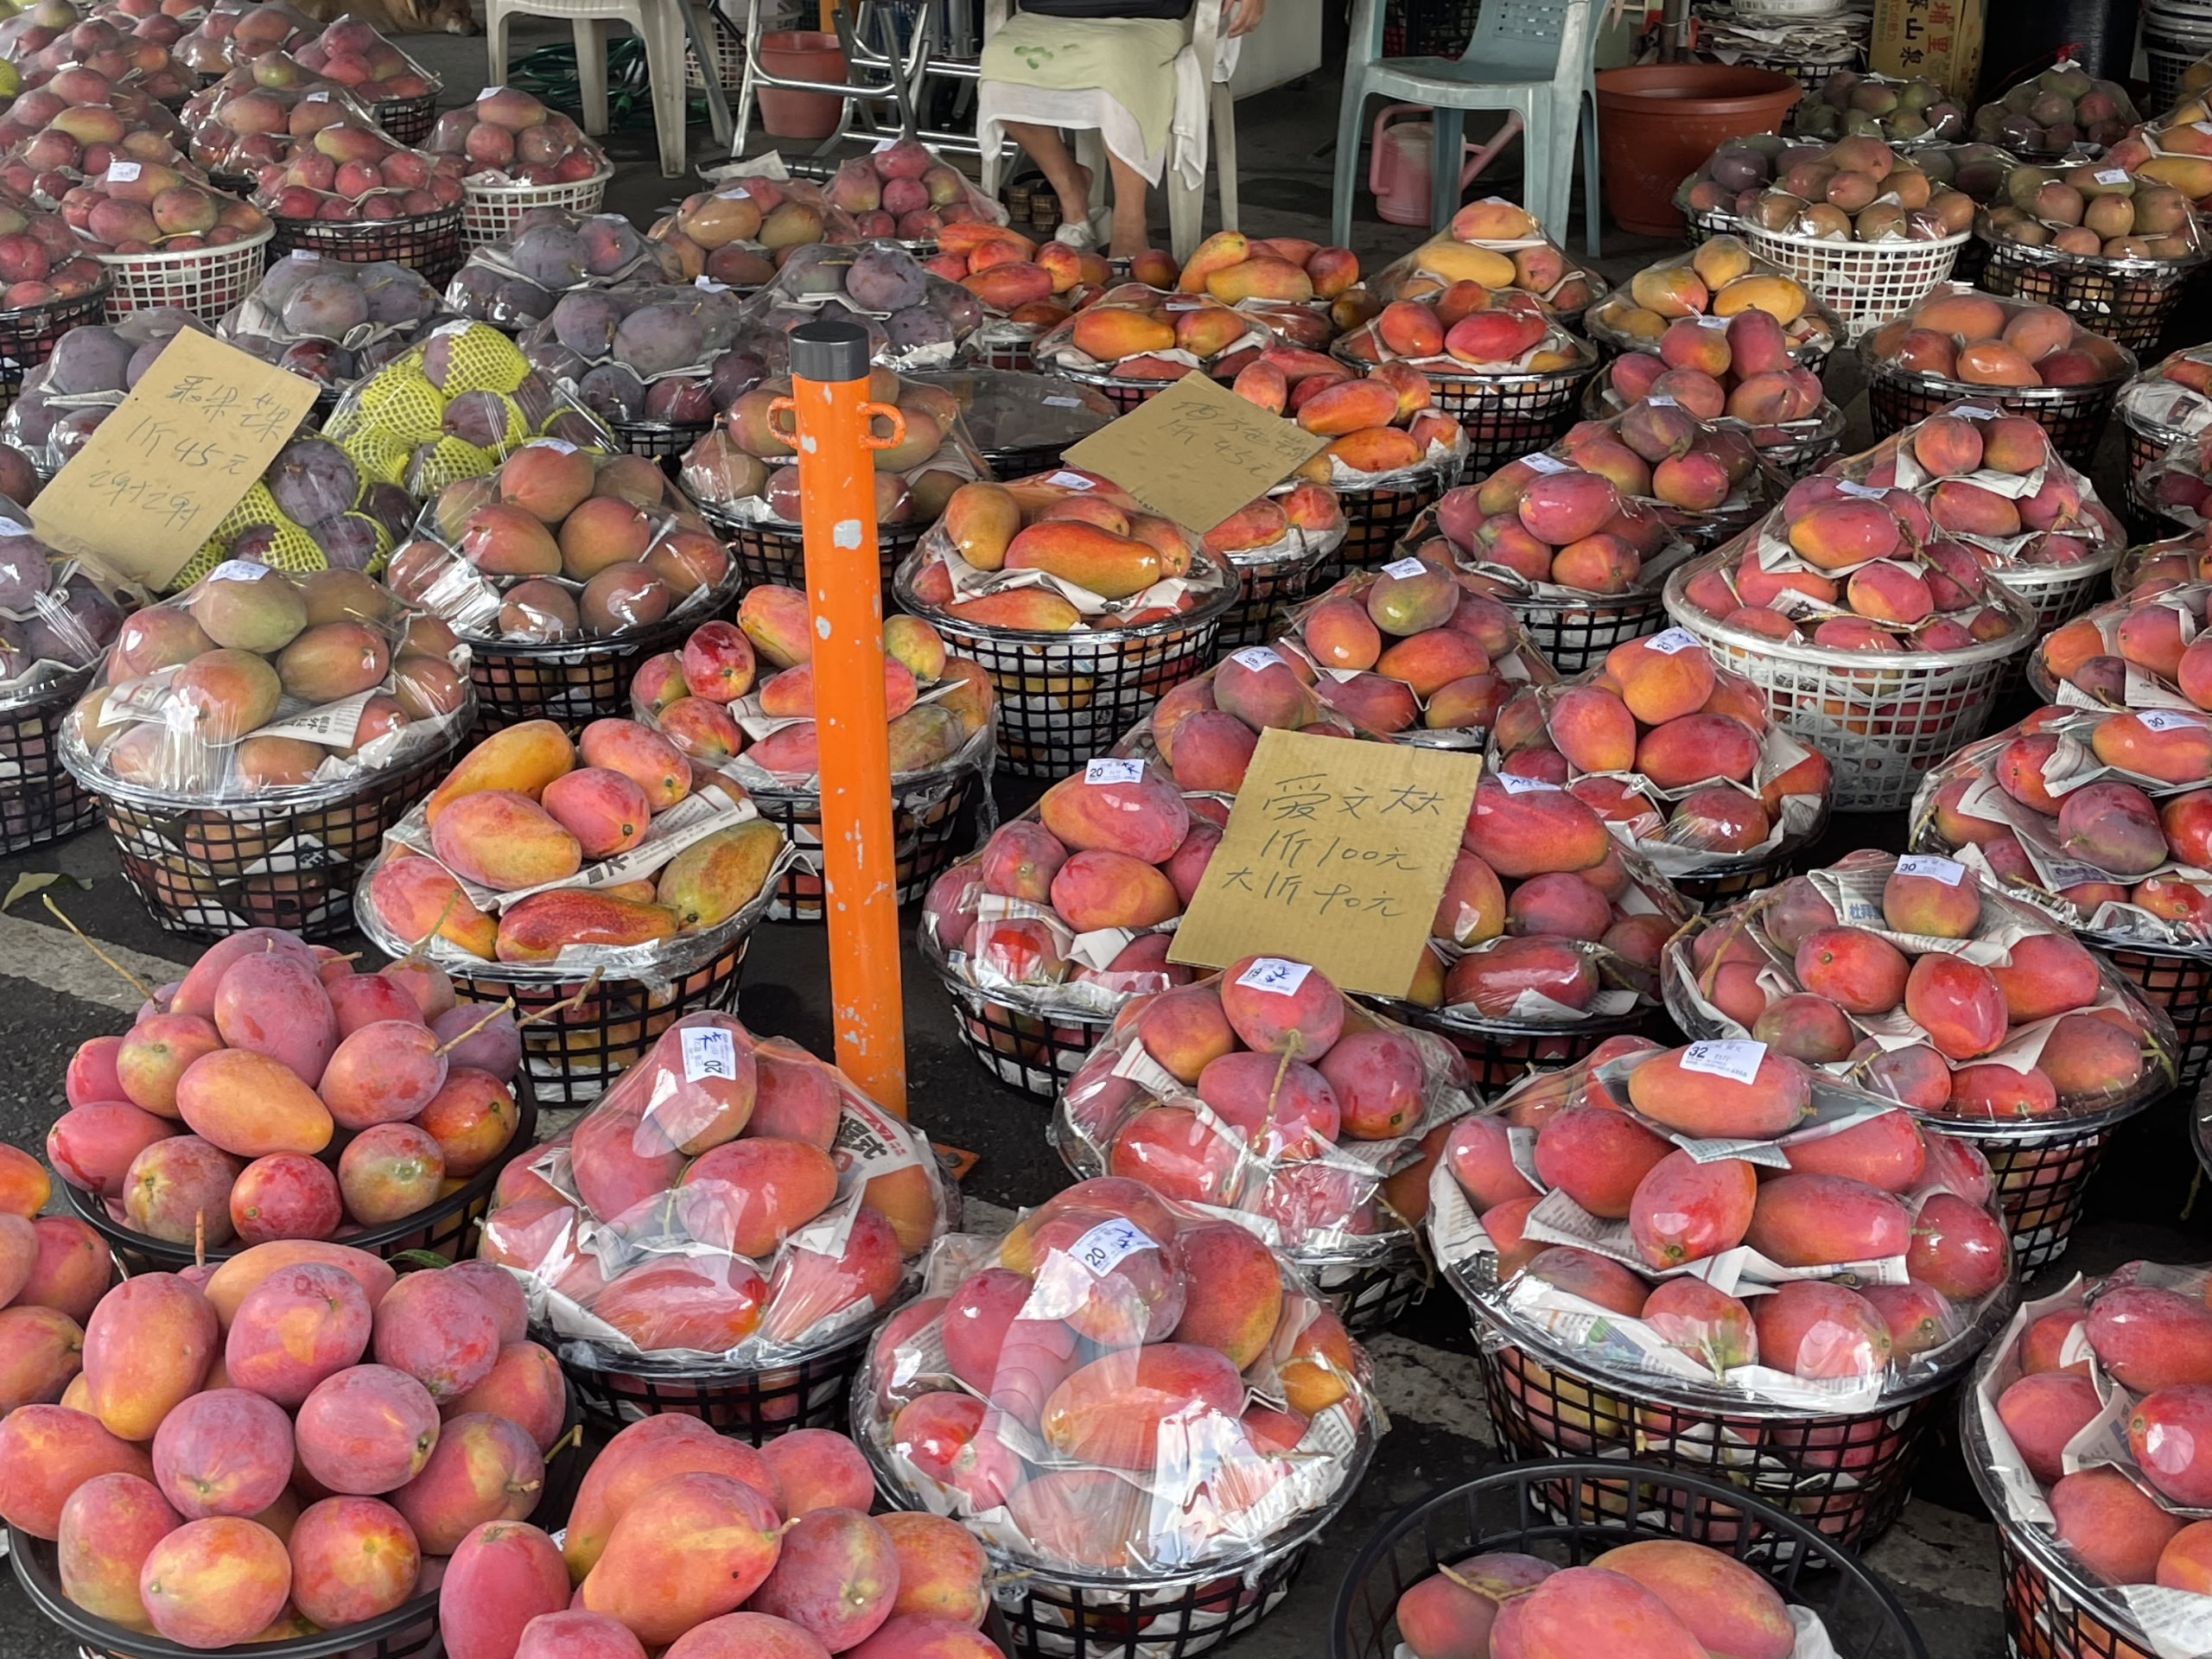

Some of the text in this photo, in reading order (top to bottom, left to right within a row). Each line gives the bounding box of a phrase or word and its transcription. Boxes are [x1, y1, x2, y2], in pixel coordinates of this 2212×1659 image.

[1090, 767, 1104, 778] 20
[1900, 862, 1916, 872] 30
[1688, 1046, 1709, 1059] 32
[703, 1059, 723, 1074] 20
[1085, 1247, 1107, 1268] 20
